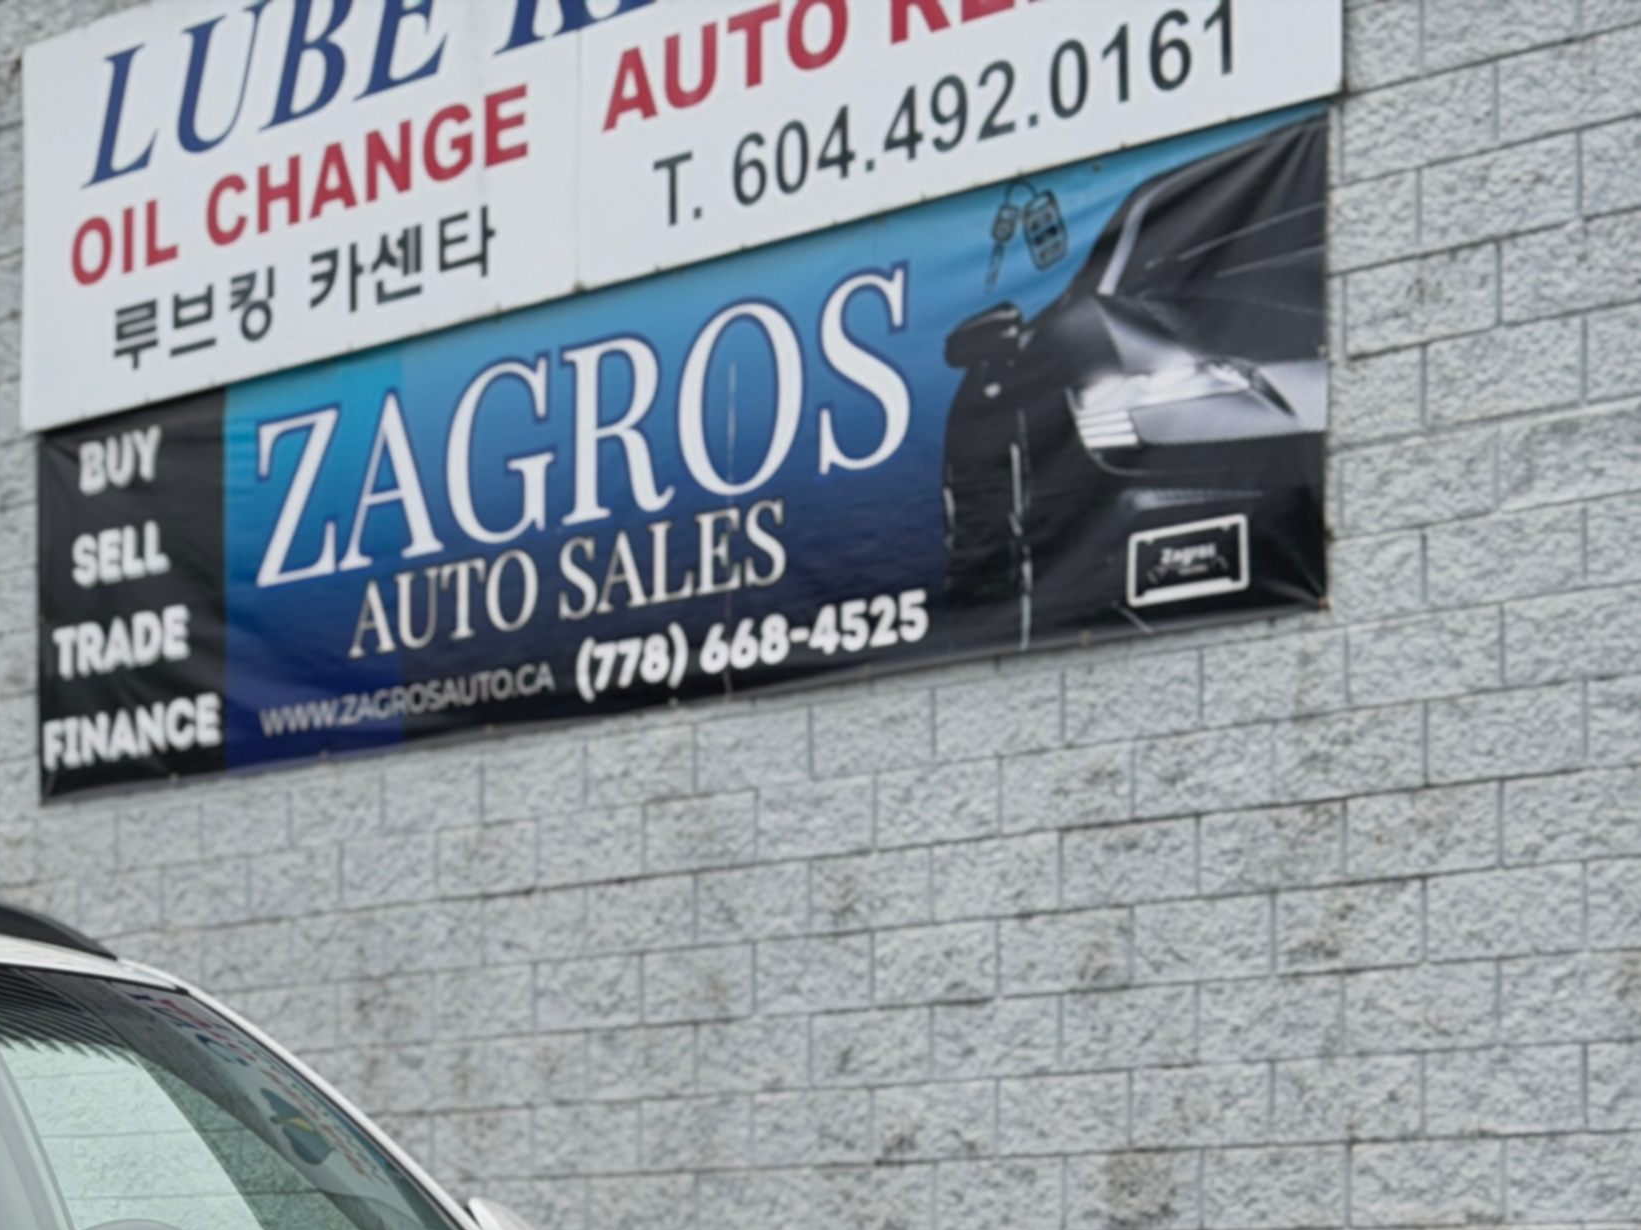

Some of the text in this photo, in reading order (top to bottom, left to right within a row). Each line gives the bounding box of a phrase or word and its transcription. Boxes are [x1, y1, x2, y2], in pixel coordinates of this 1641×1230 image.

[83, 0, 448, 188] LUBE
[602, 0, 850, 132] AUTO
[654, 0, 1235, 227] T. 604.492.0161
[71, 84, 530, 286] OIL CHANGE
[114, 206, 498, 370] 루브킹 카센타
[79, 426, 161, 495] BUY
[257, 264, 910, 588] ZAGROS
[72, 520, 170, 587] SELL
[349, 499, 787, 658] AUTO SALES
[53, 604, 190, 679] TRADE
[259, 663, 556, 738] WWW.ZAGROSAUTO.CA
[575, 589, 930, 702] (778) 668-4525
[42, 693, 223, 771] FINANCE
